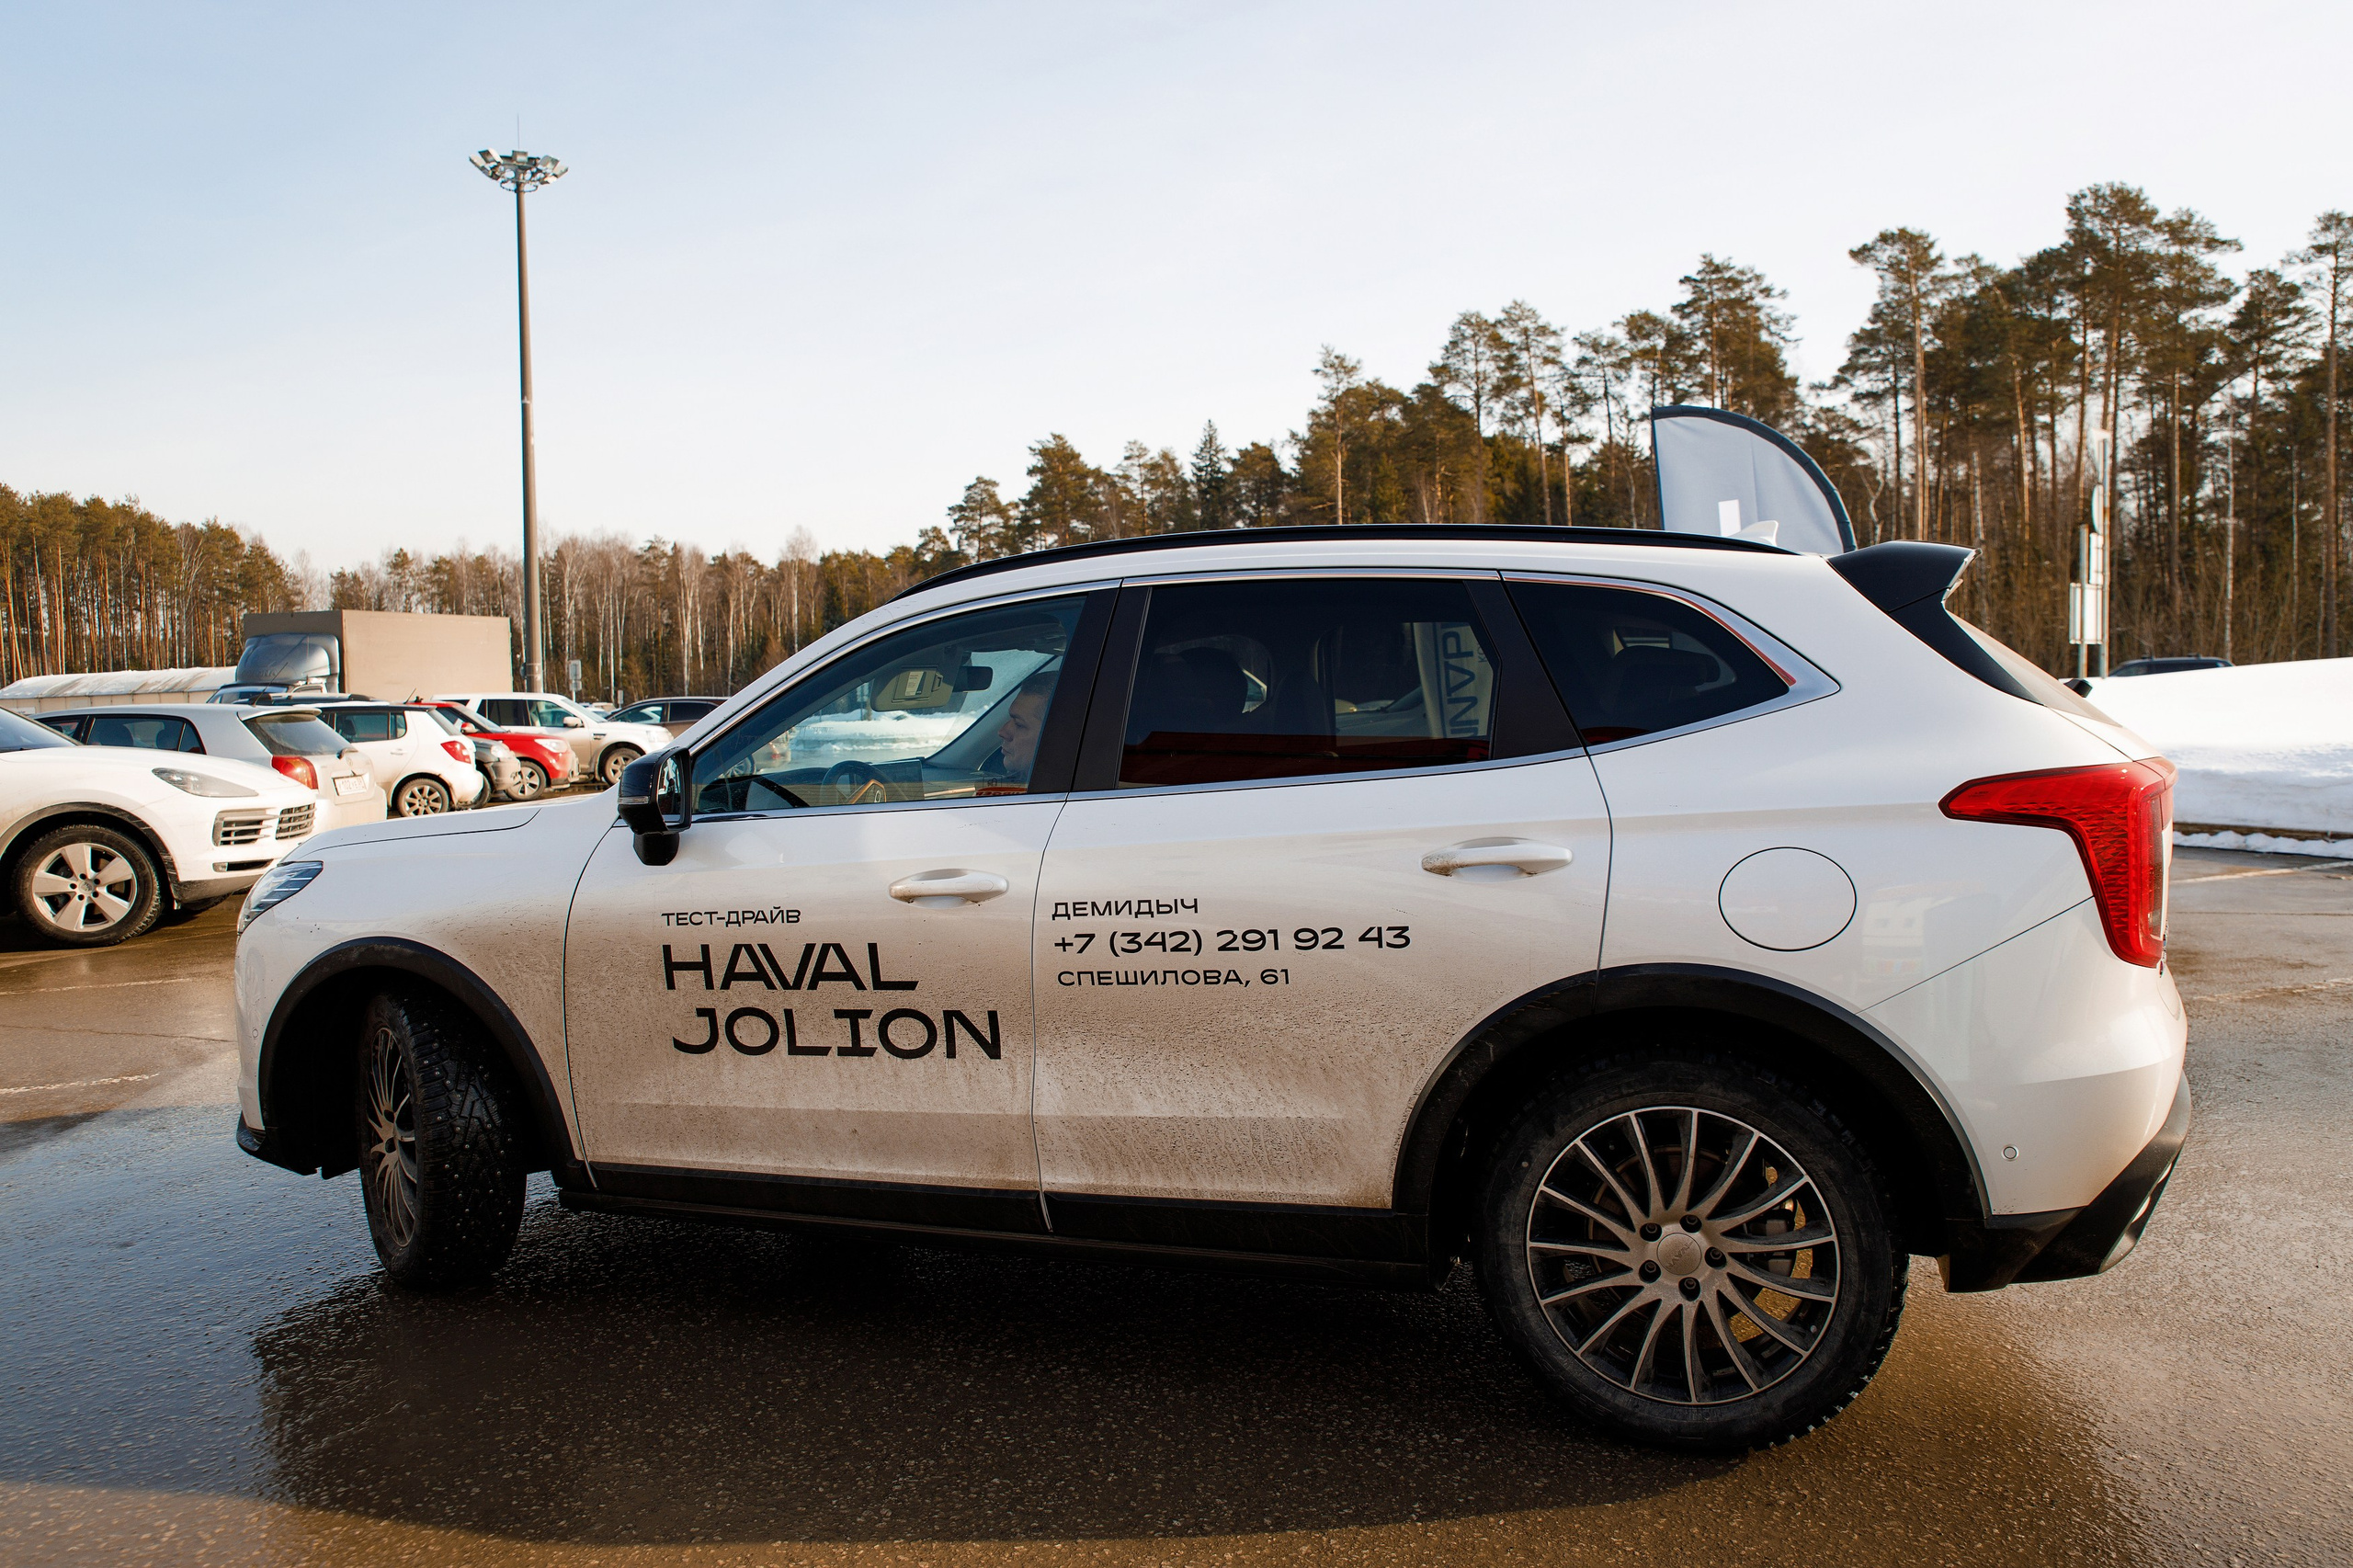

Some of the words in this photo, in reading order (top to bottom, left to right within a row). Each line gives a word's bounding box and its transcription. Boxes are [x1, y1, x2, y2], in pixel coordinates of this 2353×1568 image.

[661, 905, 801, 928] ТЕСТ-ДРАЙВ
[1051, 898, 1199, 921] ДЕМИДЫЧ
[1053, 933, 1096, 958] +7
[1109, 929, 1202, 958] (342)
[1216, 928, 1279, 952] 291
[1293, 926, 1346, 951] 92
[1358, 926, 1411, 949] 43
[662, 942, 919, 991] HAVAL
[1057, 969, 1251, 988] СПЕШИЛОВА,
[1259, 968, 1290, 985] 61
[672, 1006, 1002, 1061] JOLION
